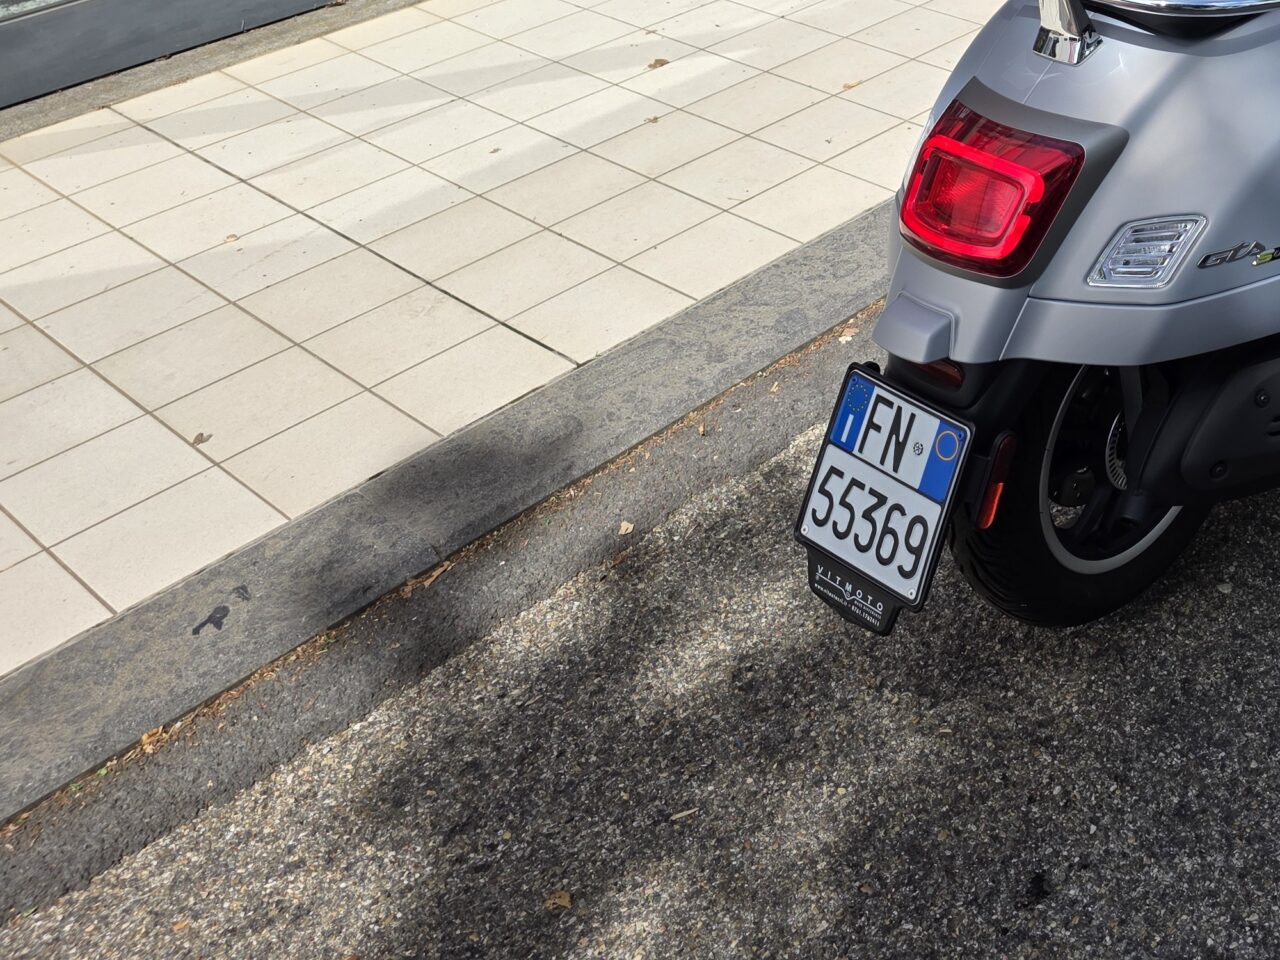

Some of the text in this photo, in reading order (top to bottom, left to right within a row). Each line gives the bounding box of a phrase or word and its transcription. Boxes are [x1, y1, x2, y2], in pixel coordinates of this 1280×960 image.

[857, 393, 917, 474] FN
[811, 464, 930, 580] 55369
[817, 563, 884, 612] VITMOTO
